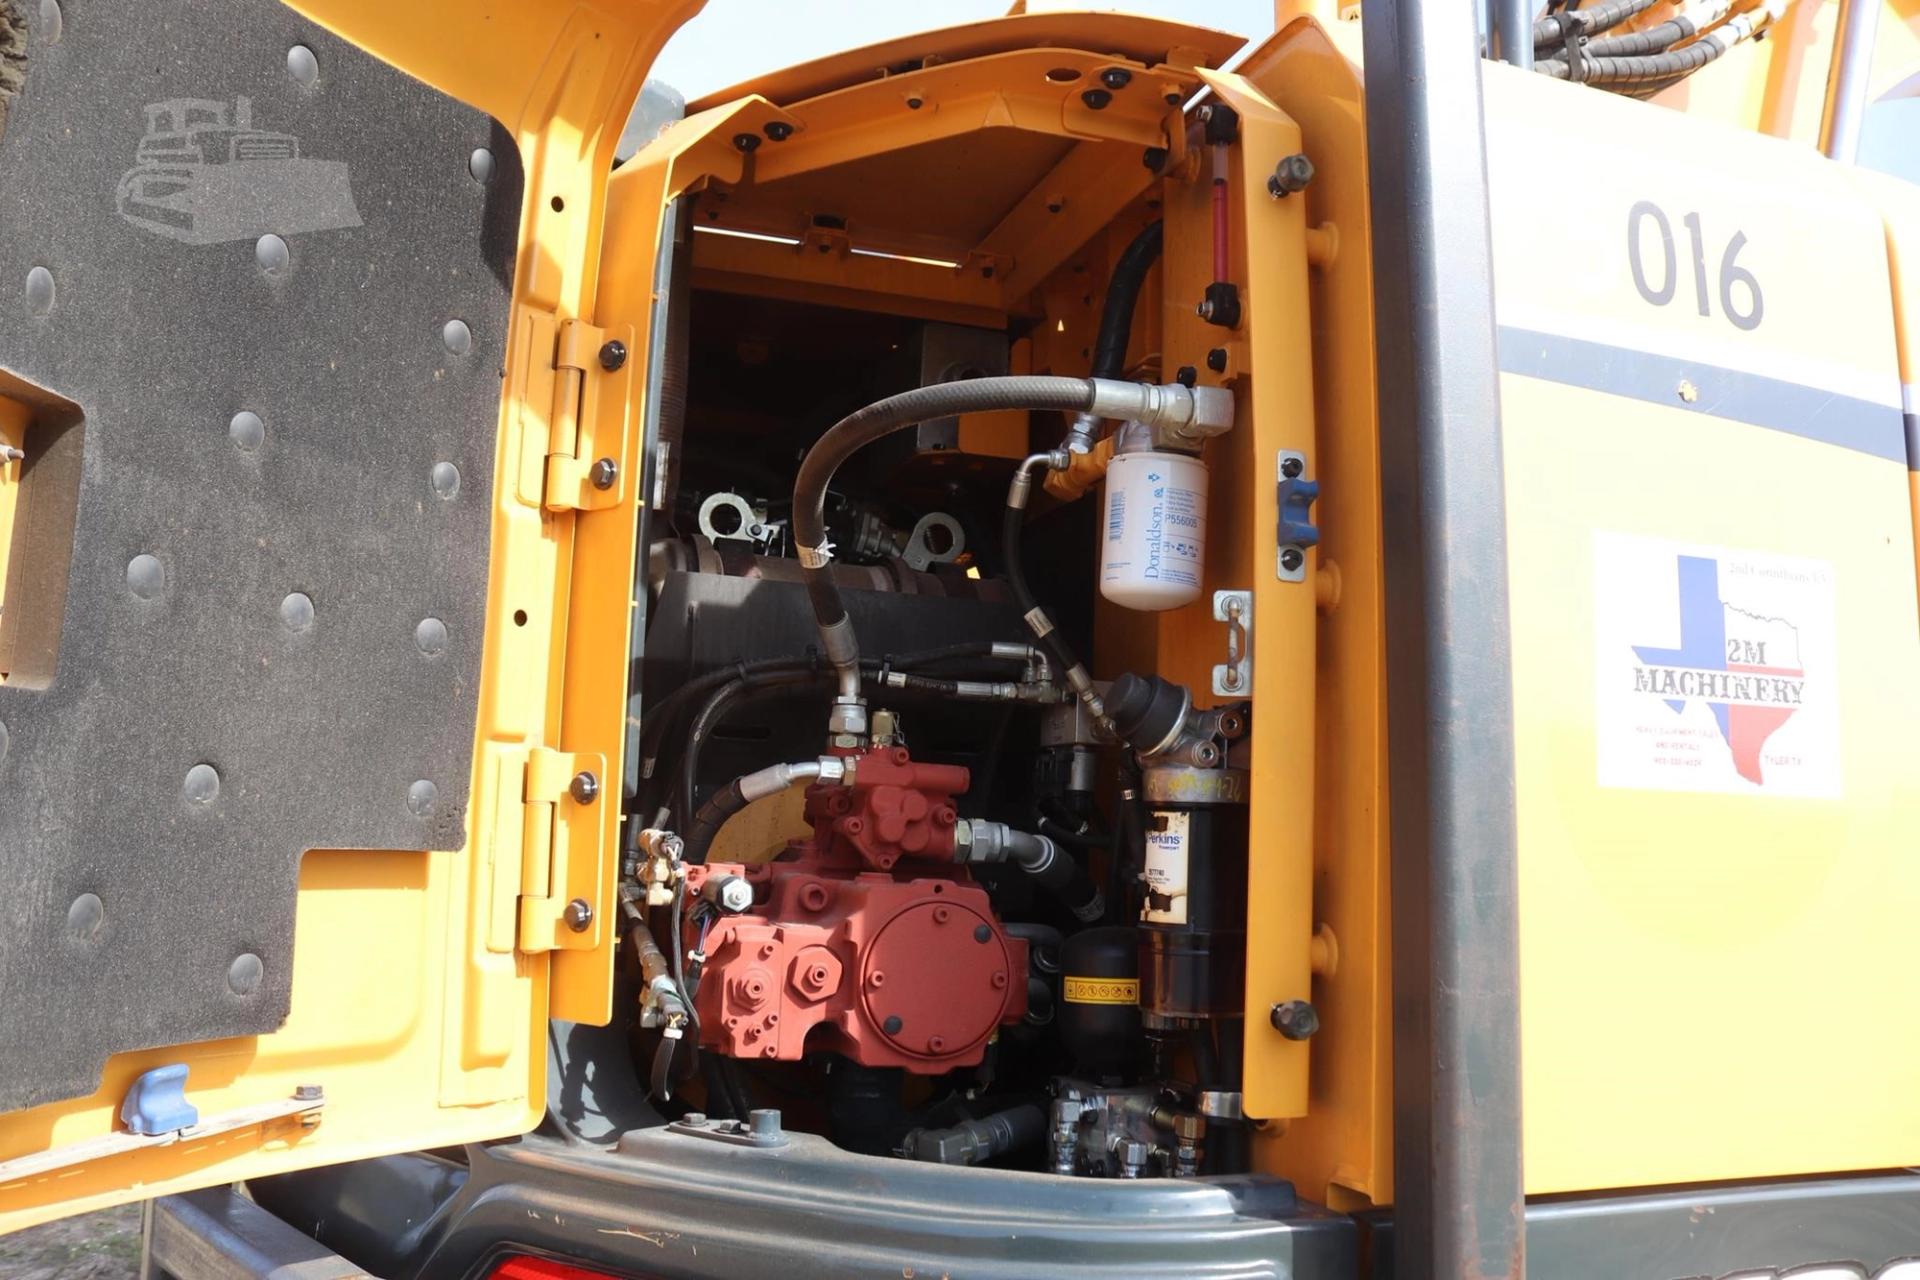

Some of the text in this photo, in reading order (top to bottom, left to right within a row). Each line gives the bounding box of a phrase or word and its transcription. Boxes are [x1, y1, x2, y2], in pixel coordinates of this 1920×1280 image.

[1628, 200, 1764, 331] 016
[1144, 506, 1164, 579] Donaldson
[1727, 638, 1767, 665] 2M
[1633, 667, 1805, 705] MACHINERY
